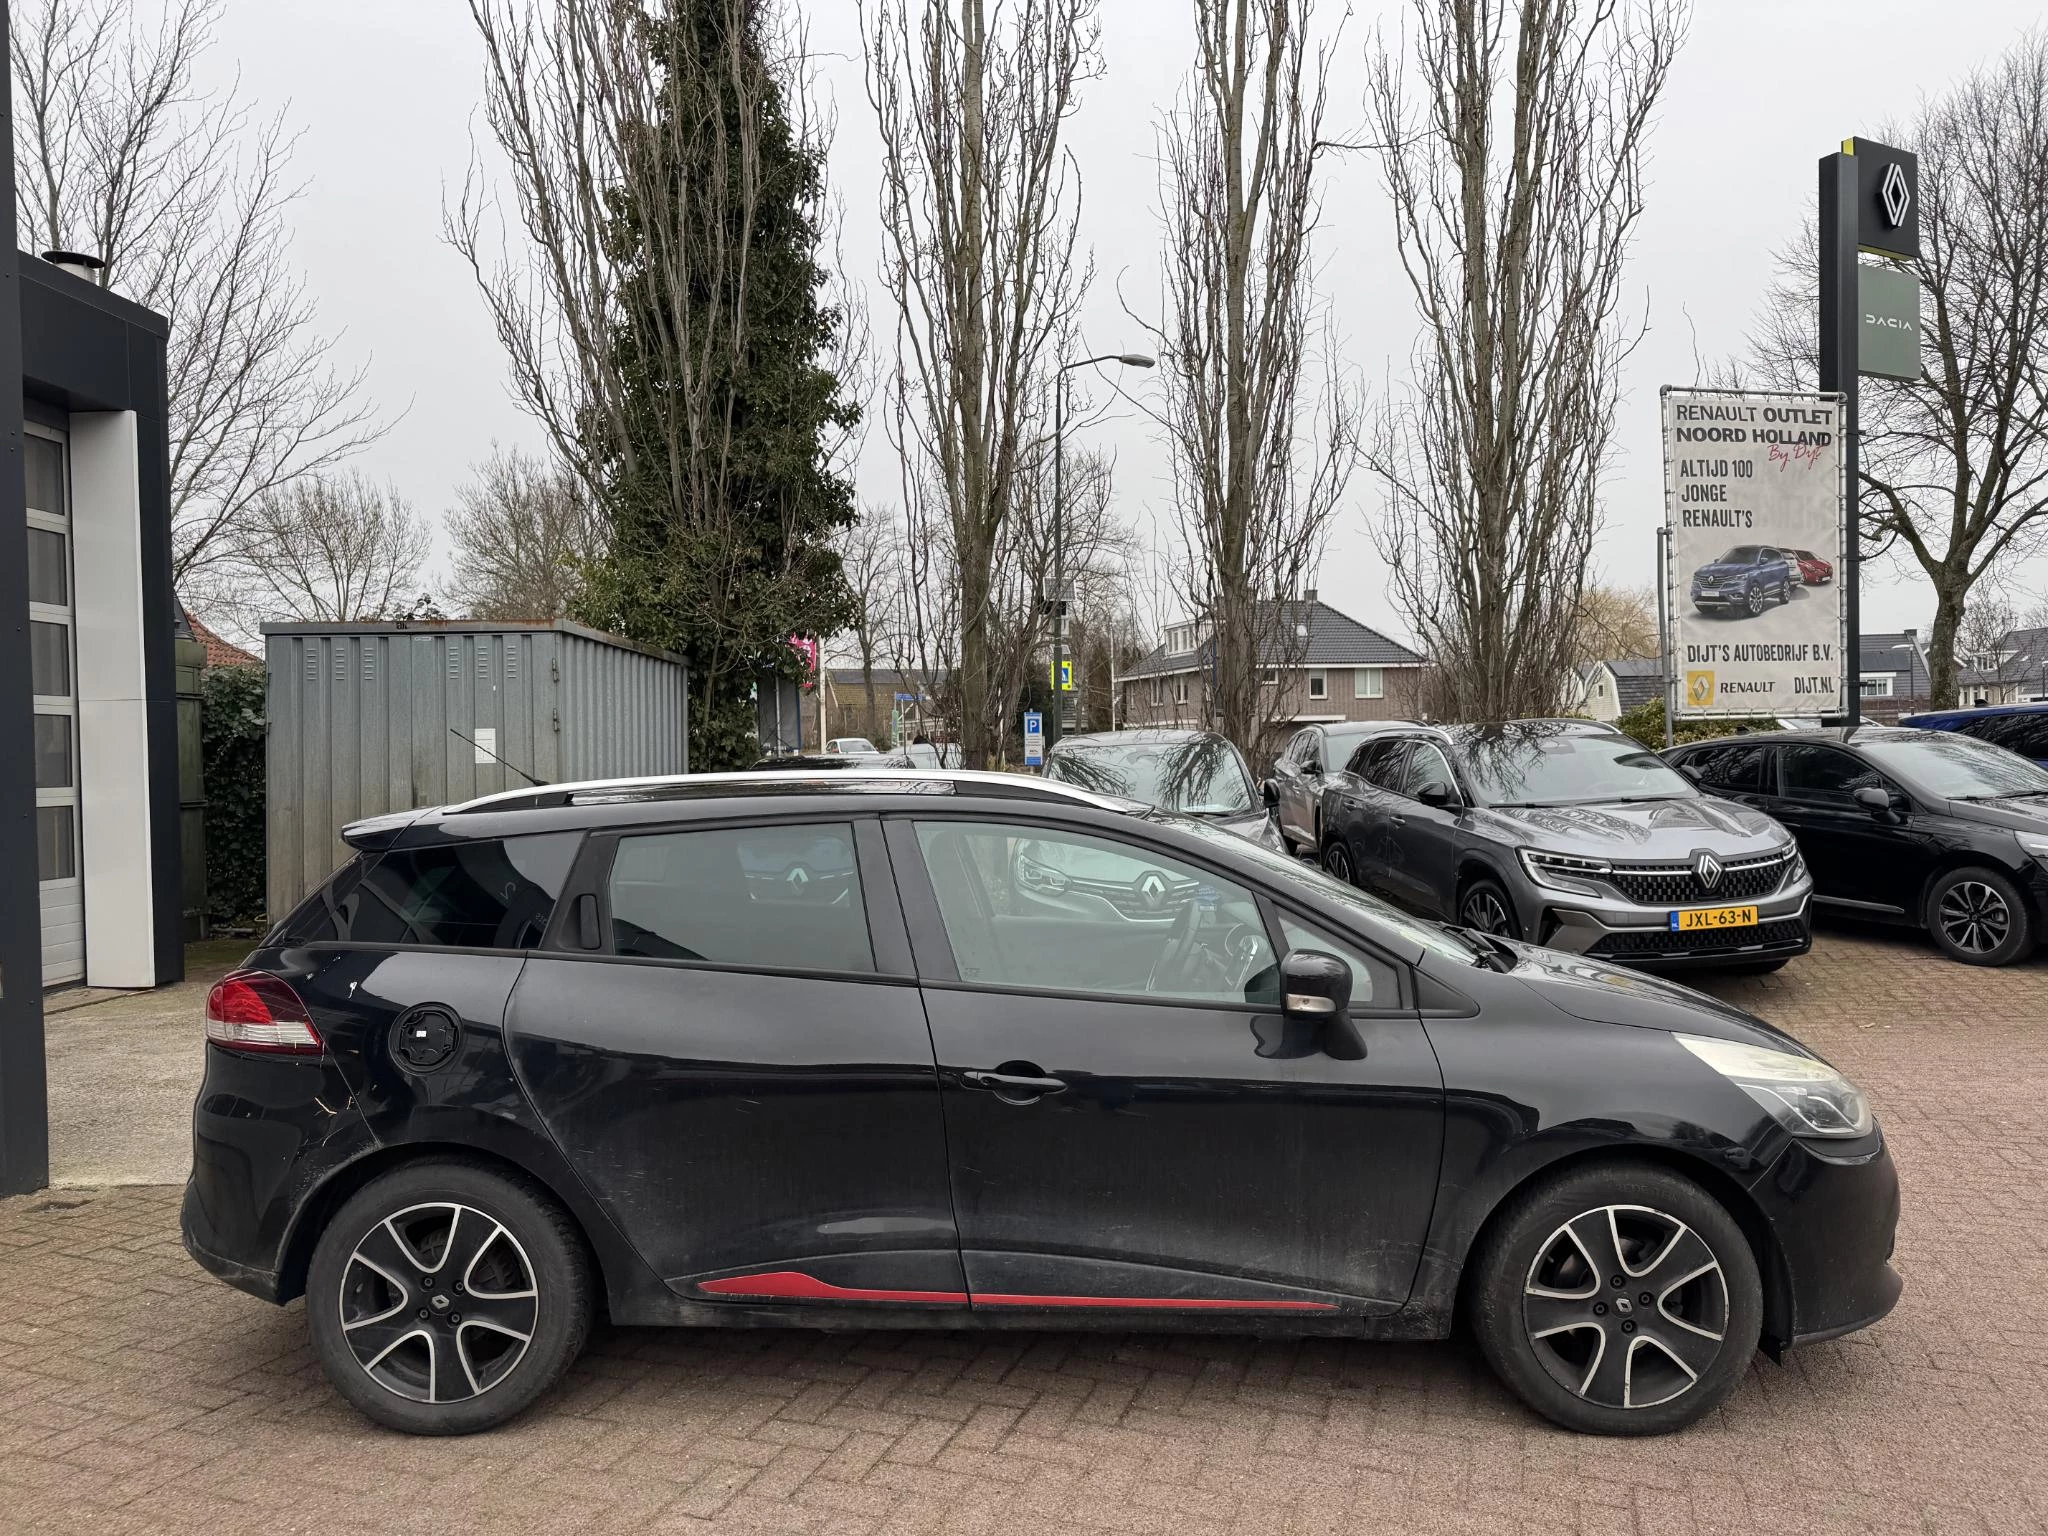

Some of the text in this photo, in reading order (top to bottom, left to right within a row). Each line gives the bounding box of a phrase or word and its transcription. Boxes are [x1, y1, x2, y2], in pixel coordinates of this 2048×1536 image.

[1865, 313, 1913, 331] DACIA
[1676, 404, 1833, 425] RENAULT OUTLET
[1676, 427, 1832, 447] NOORD HOLLAND
[1768, 443, 1790, 472] By
[1680, 459, 1753, 478] ALTIJD 100
[1681, 484, 1727, 502] JONGE
[1682, 509, 1753, 528] RENAULT'S
[1687, 644, 1834, 663] DIJT'S AUTOBEDRIJF B.V.
[1720, 681, 1776, 694] RENAULT
[1794, 676, 1835, 694] DIJT.NL
[1029, 720, 1037, 732] P
[1686, 909, 1751, 927] JXL-63-N
